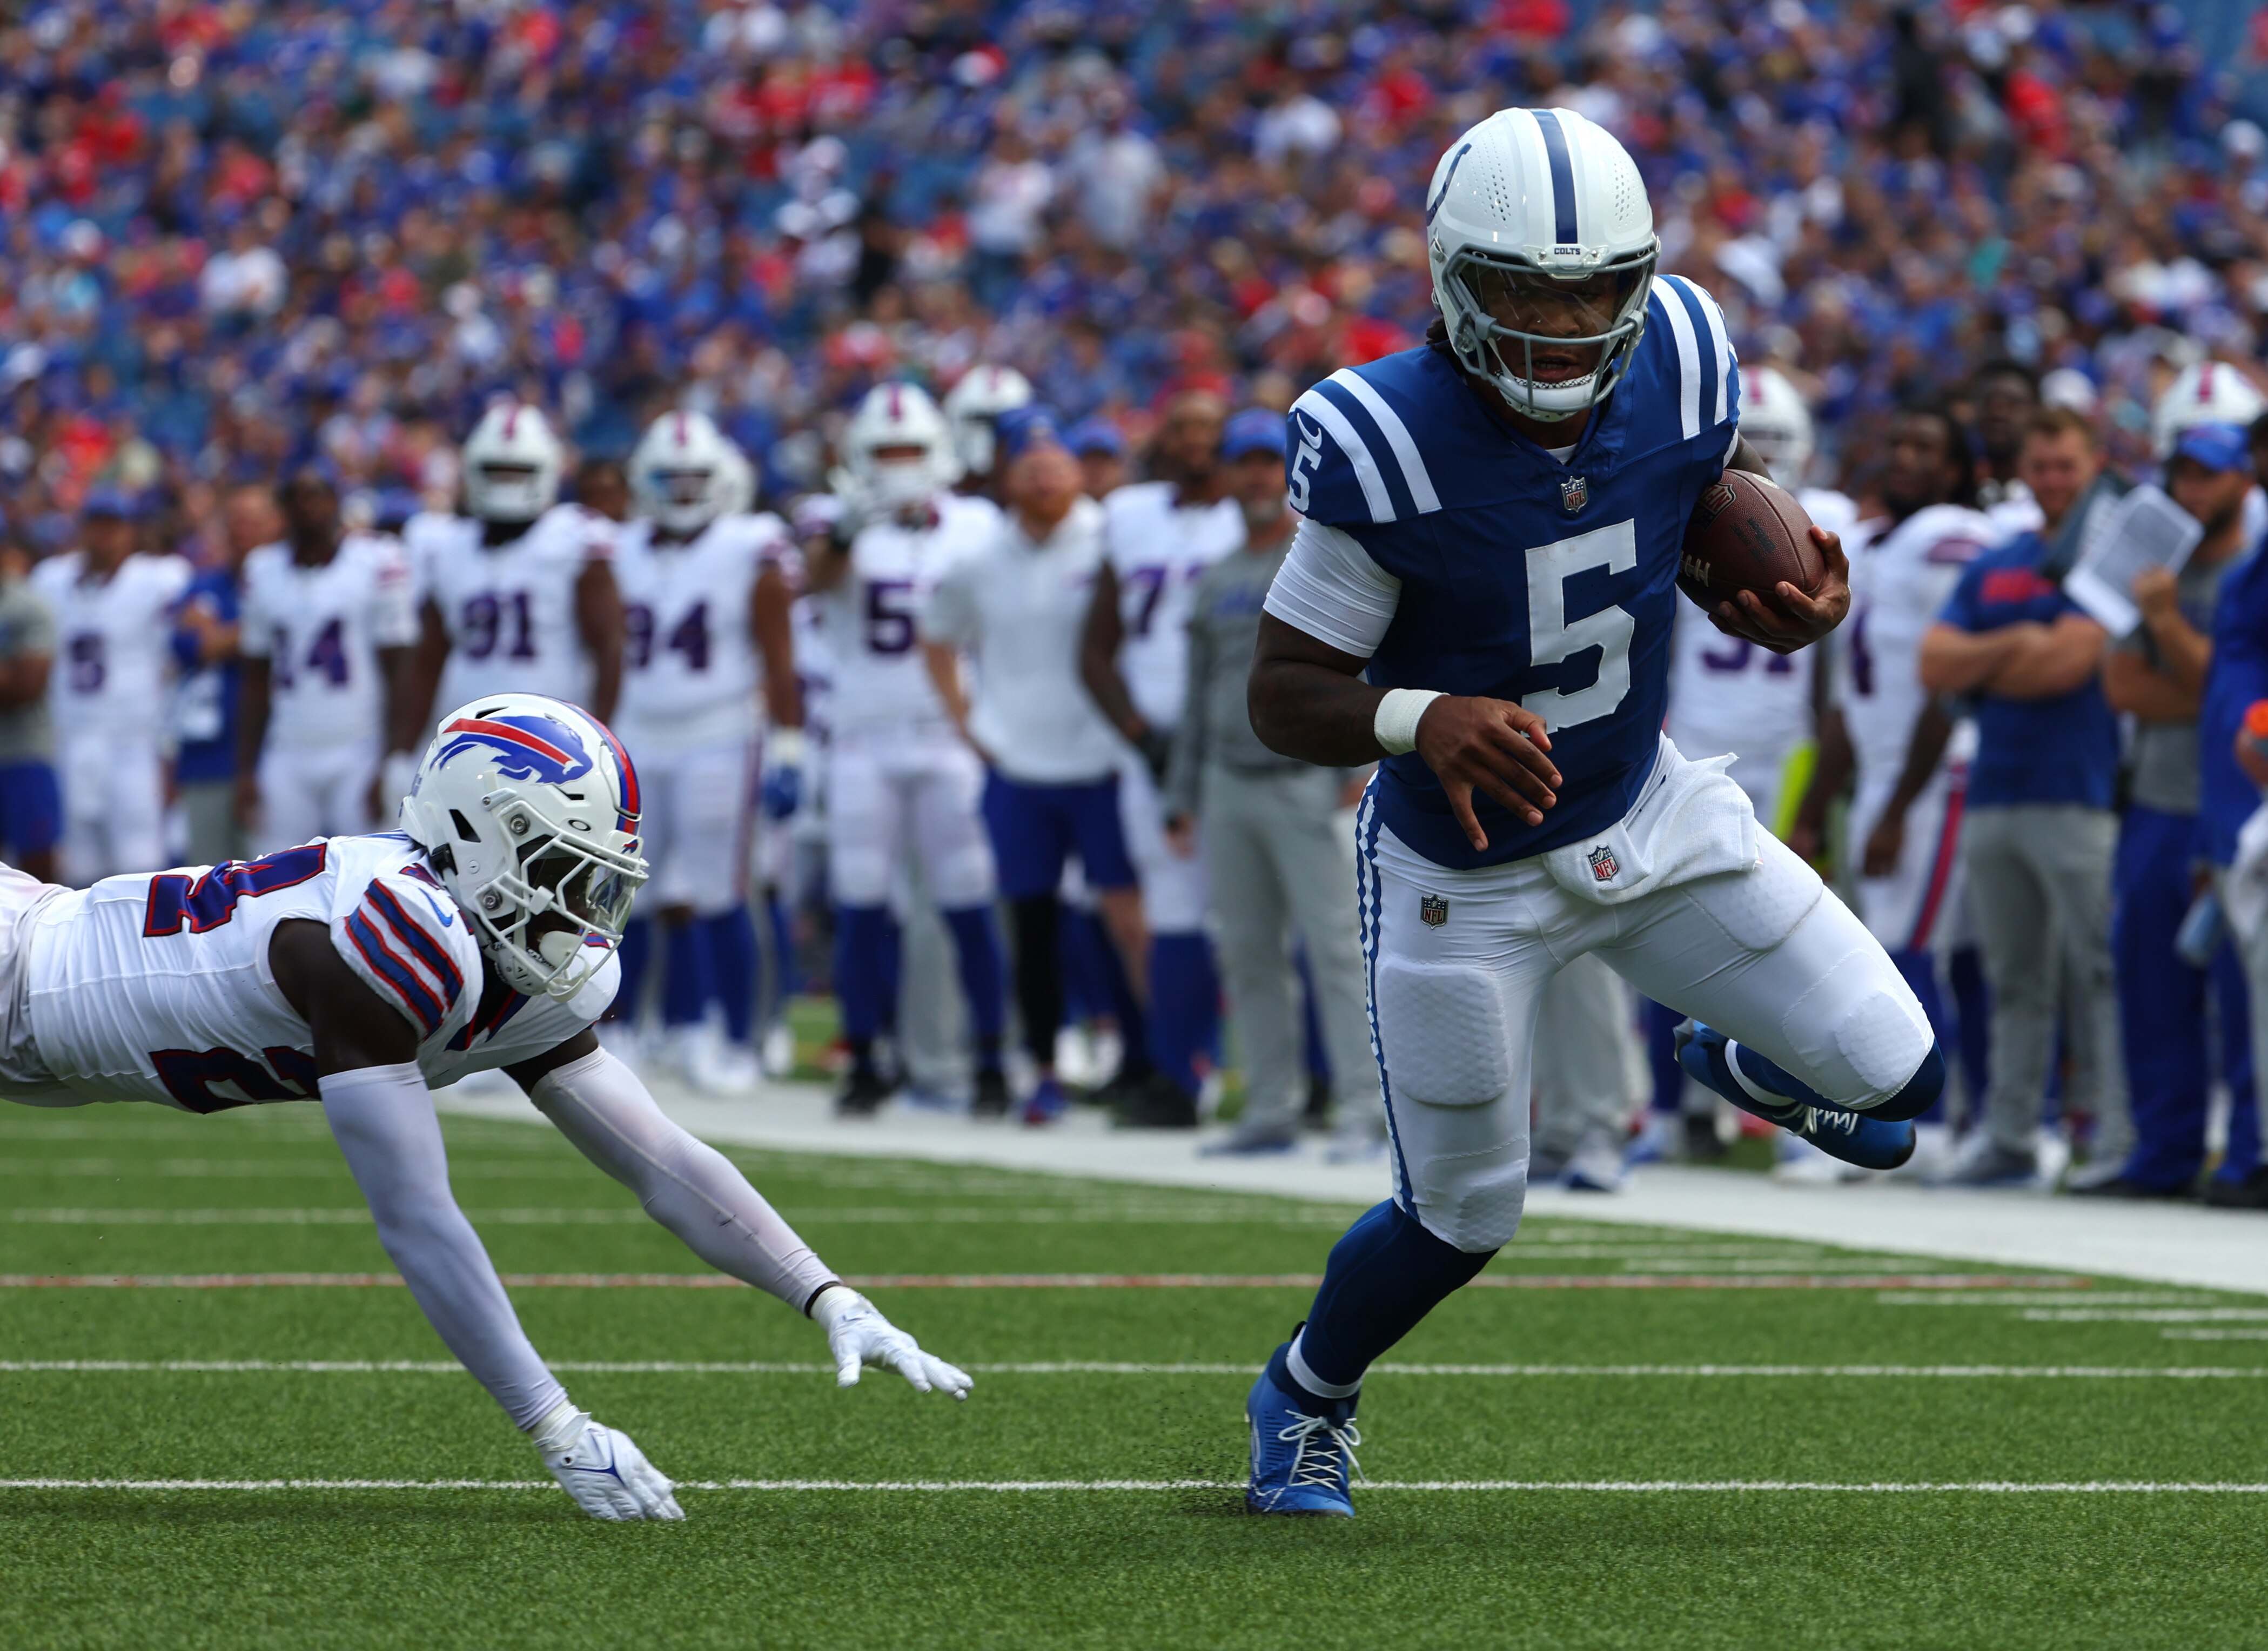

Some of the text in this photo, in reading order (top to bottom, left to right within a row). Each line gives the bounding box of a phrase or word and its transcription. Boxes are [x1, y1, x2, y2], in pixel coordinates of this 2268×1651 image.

[1289, 439, 1322, 513] 5
[1567, 491, 1585, 507] NFL
[463, 592, 535, 659] 91
[1521, 518, 1636, 738] 5
[1594, 858, 1618, 878] NFL
[1424, 908, 1444, 924] NFL
